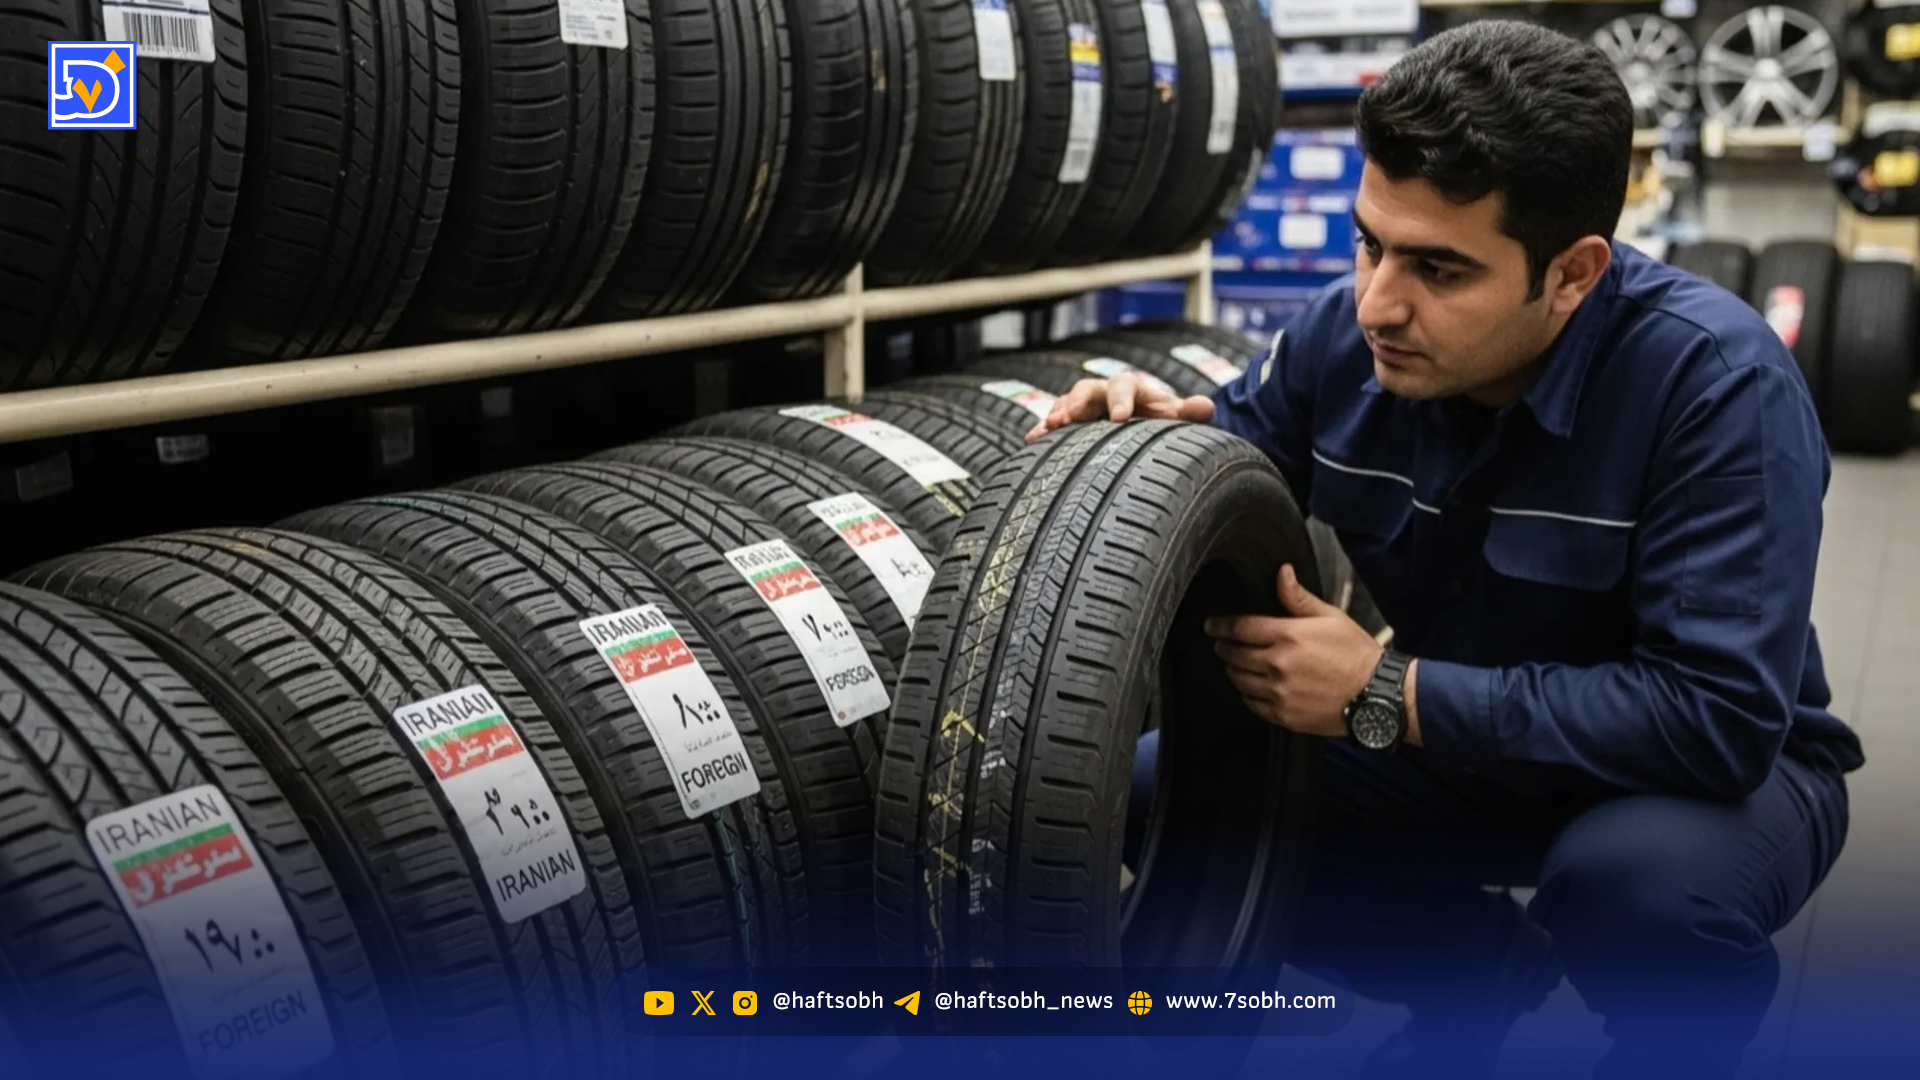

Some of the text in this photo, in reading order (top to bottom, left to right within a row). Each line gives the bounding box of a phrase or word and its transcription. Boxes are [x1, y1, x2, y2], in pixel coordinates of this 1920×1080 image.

[95, 793, 222, 854] IRANIAN
[495, 848, 577, 902] IRANIAN
[199, 989, 308, 1057] FOREIGN
